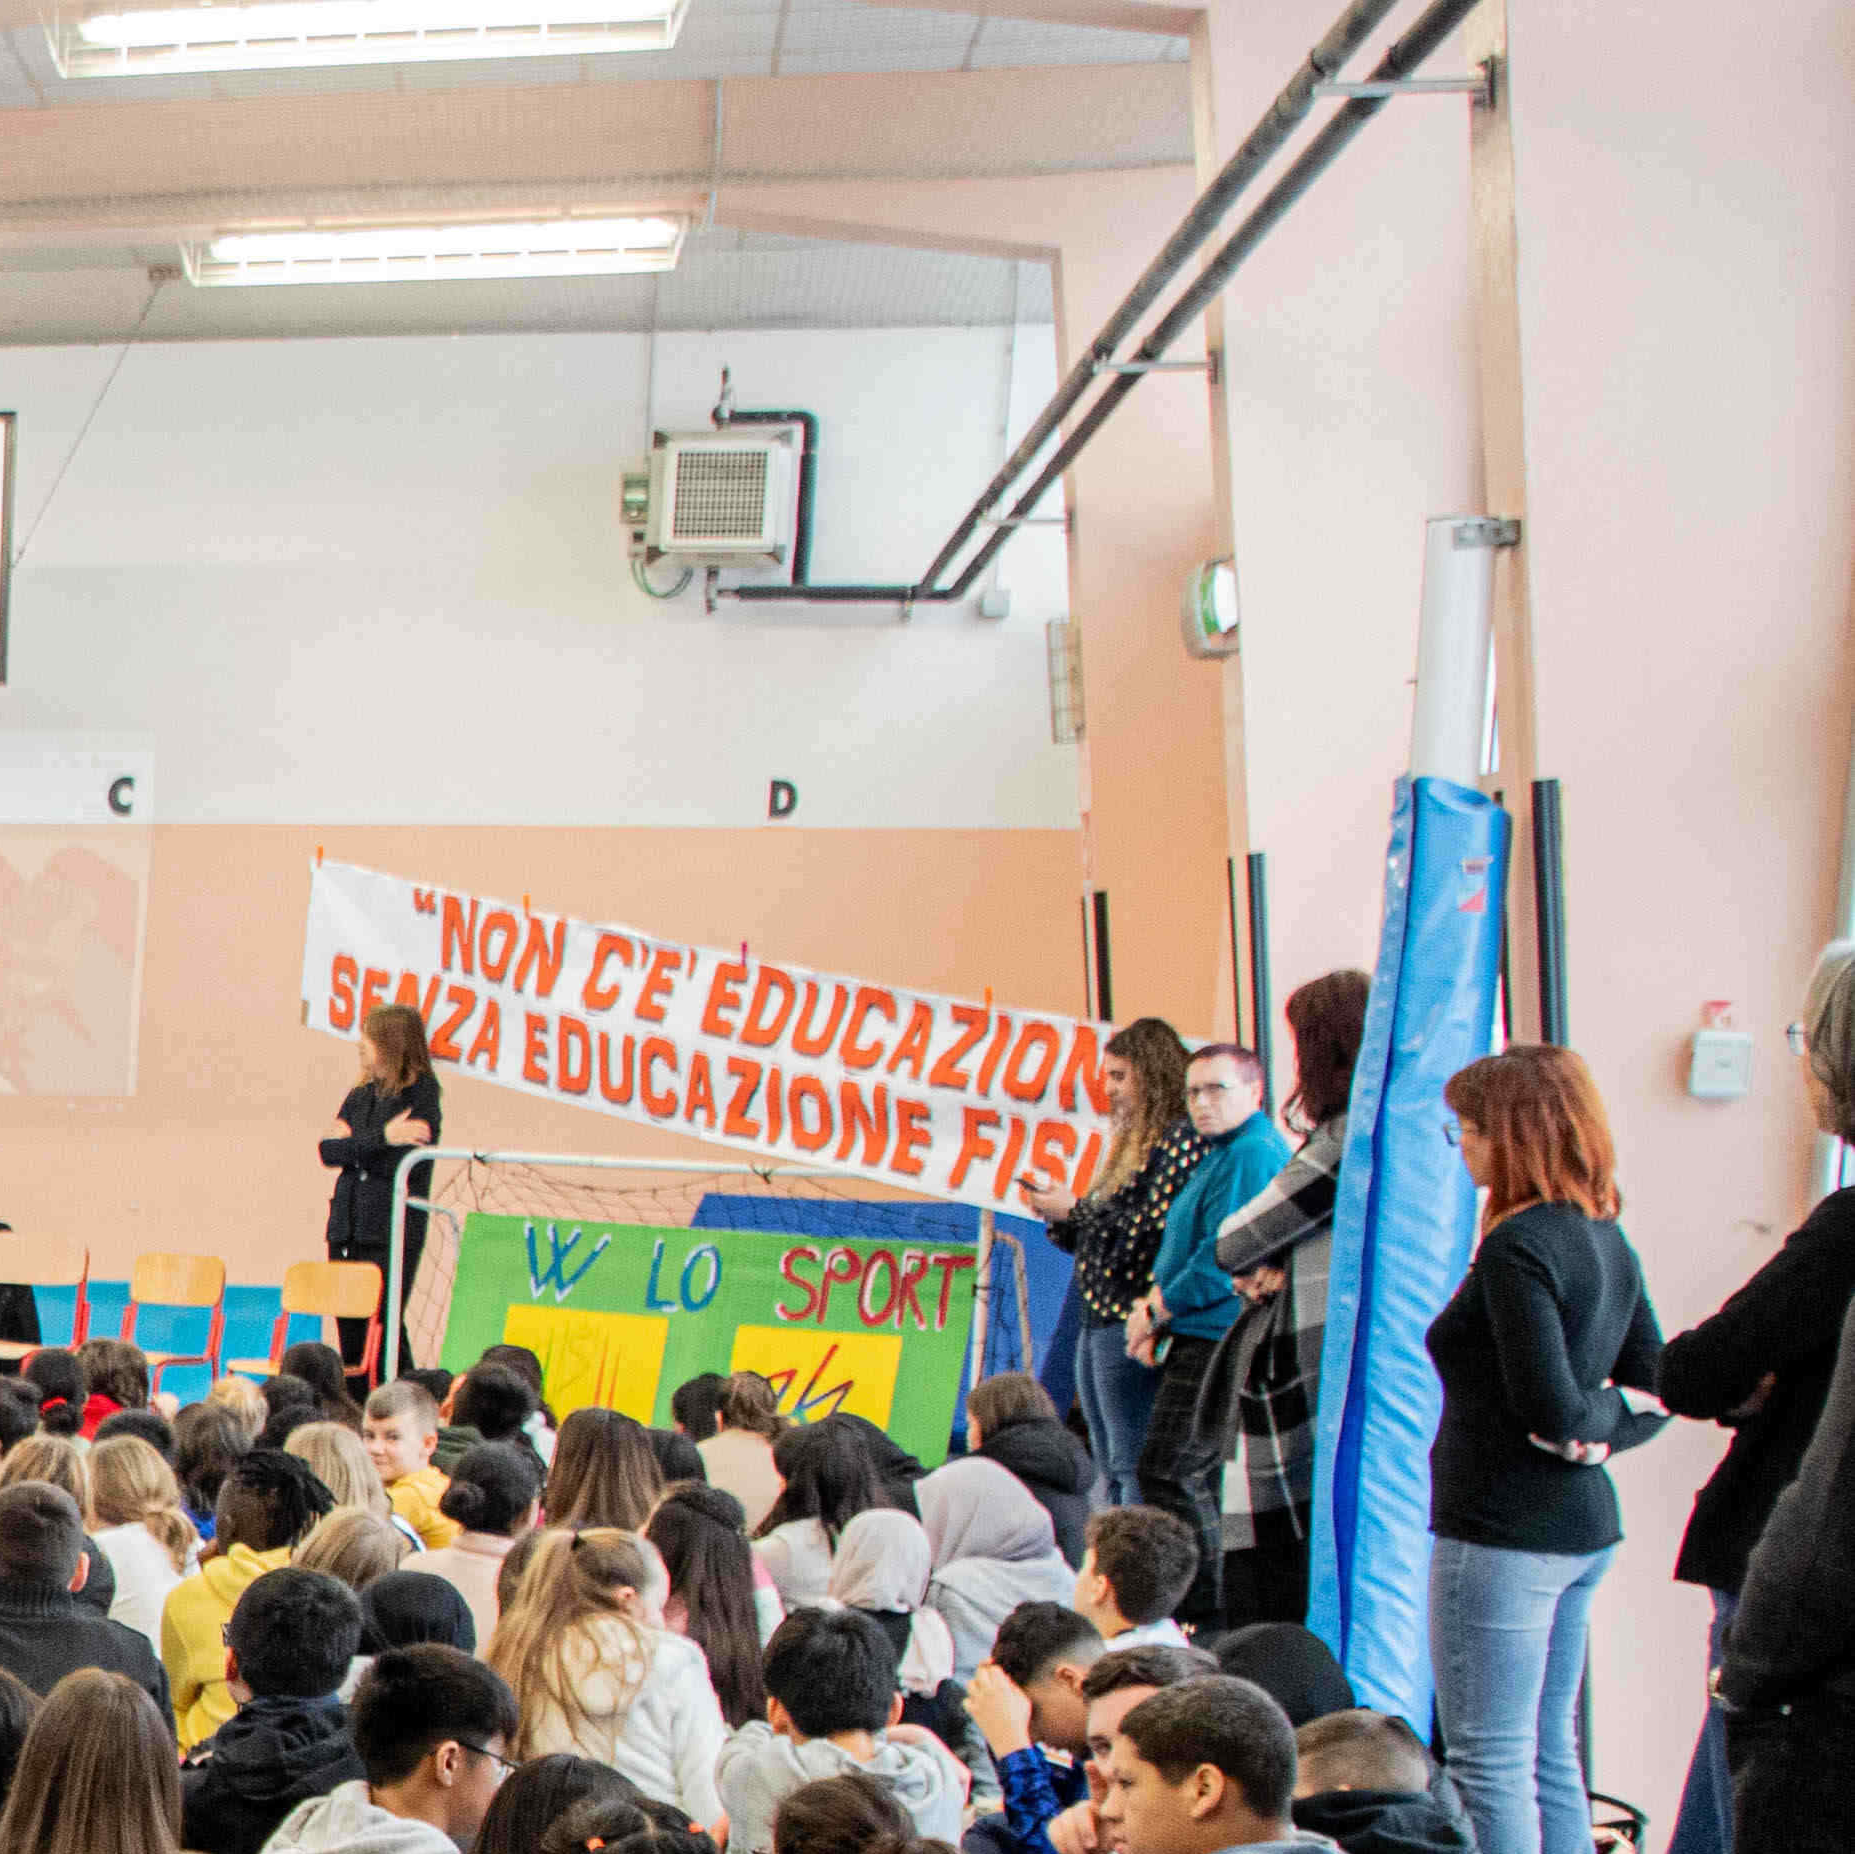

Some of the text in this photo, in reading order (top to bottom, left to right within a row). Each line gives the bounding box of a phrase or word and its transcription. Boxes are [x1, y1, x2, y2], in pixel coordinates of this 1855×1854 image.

[108, 776, 134, 815] C
[770, 779, 796, 818] D
[328, 952, 502, 1073] SENZA
[522, 1010, 933, 1177] EDUCAZIONE
[525, 1221, 976, 1331] W LO SPORT
